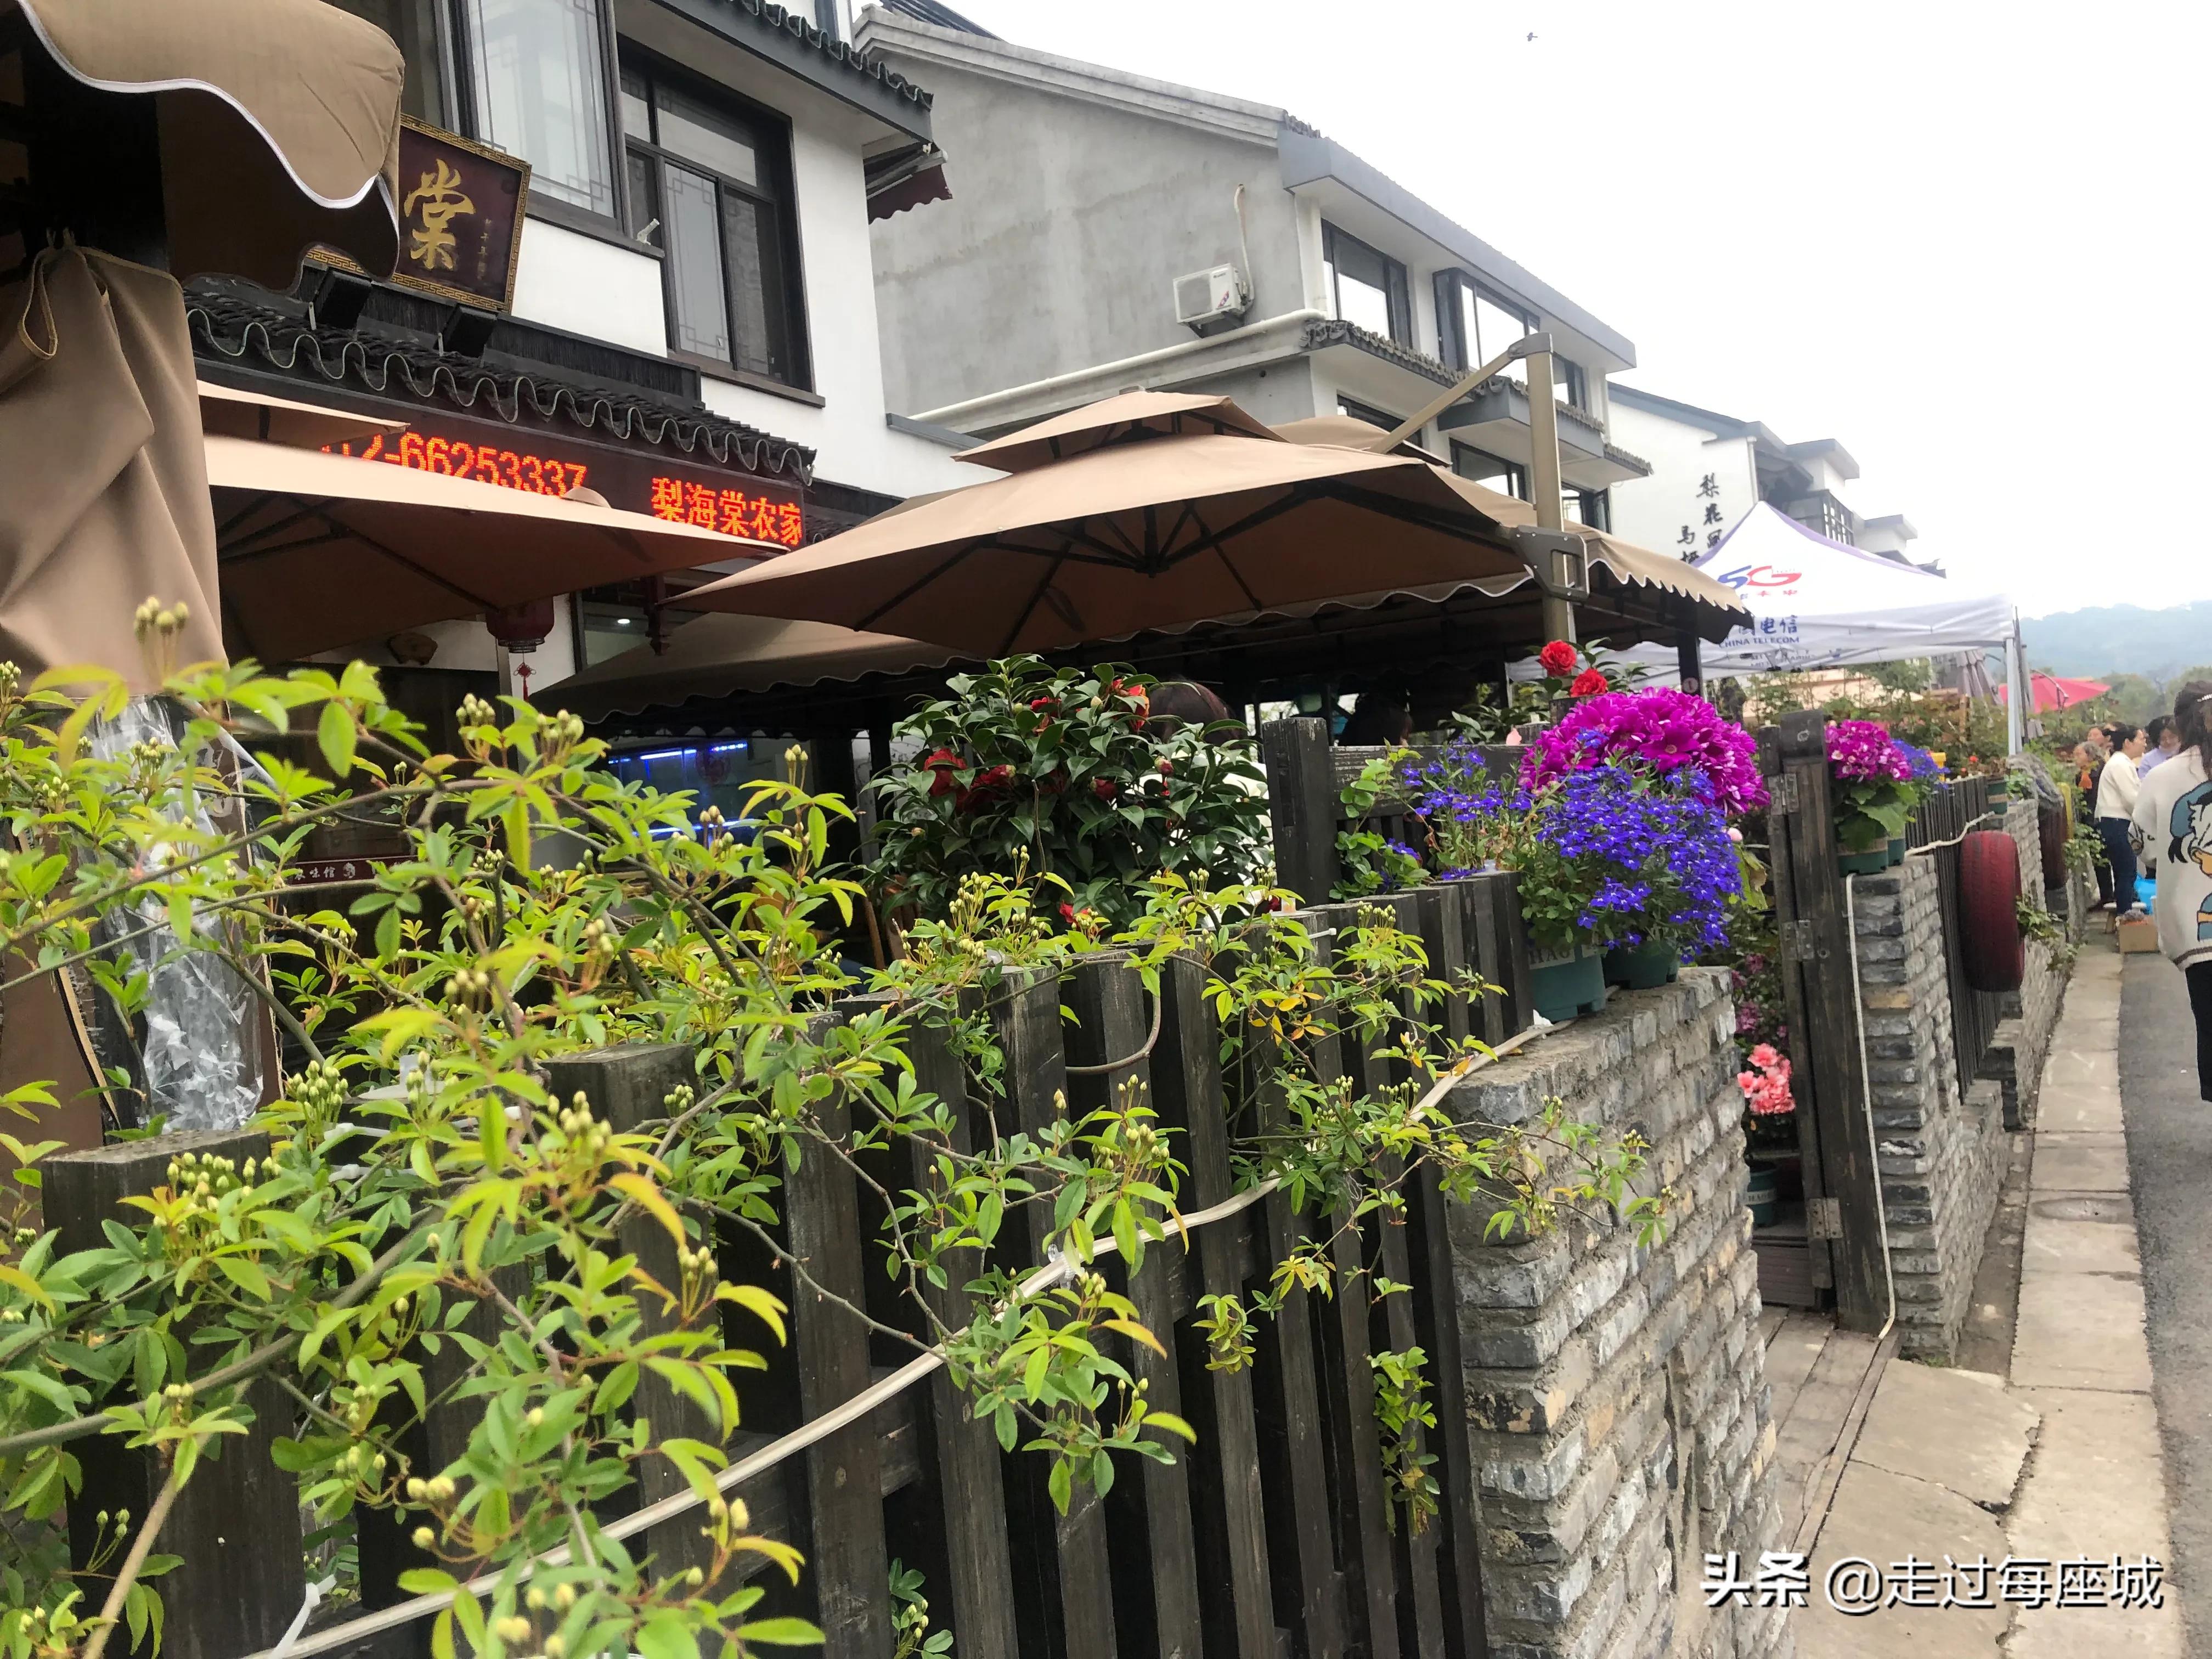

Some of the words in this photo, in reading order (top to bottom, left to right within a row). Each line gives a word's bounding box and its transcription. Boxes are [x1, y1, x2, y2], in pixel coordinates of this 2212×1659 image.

[404, 158, 476, 270] 棠
[651, 477, 803, 546] 梨海棠农家
[1718, 565, 1802, 589] 5G
